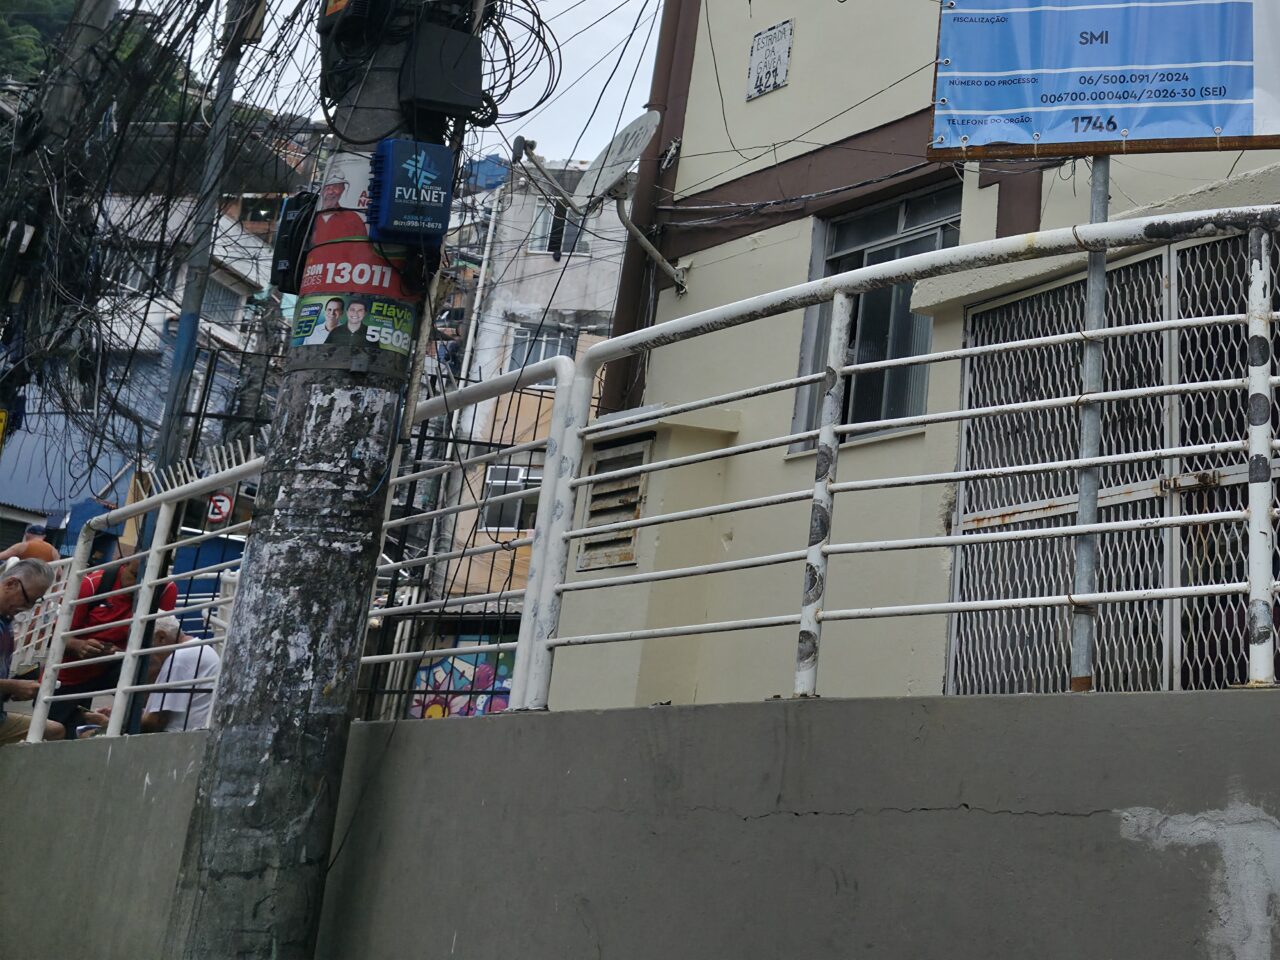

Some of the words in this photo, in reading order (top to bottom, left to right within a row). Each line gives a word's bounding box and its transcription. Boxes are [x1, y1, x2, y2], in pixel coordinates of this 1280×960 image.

[952, 15, 1009, 25] FISCALIZAÇÃO:
[1078, 30, 1109, 46] SMI
[764, 46, 776, 60] DA
[754, 67, 779, 90] 427
[948, 77, 982, 87] NÚMERO
[984, 79, 996, 87] DO
[998, 77, 1039, 87] PROCESSO:
[1078, 72, 1189, 86] 06/500.091/2024
[1200, 85, 1227, 99] (SEI)
[947, 117, 988, 126] TELEFONE
[1071, 115, 1118, 134] 1746
[395, 186, 418, 201] FVL
[420, 189, 447, 203] NET
[325, 262, 393, 288] 13011
[371, 301, 412, 320] Flávio
